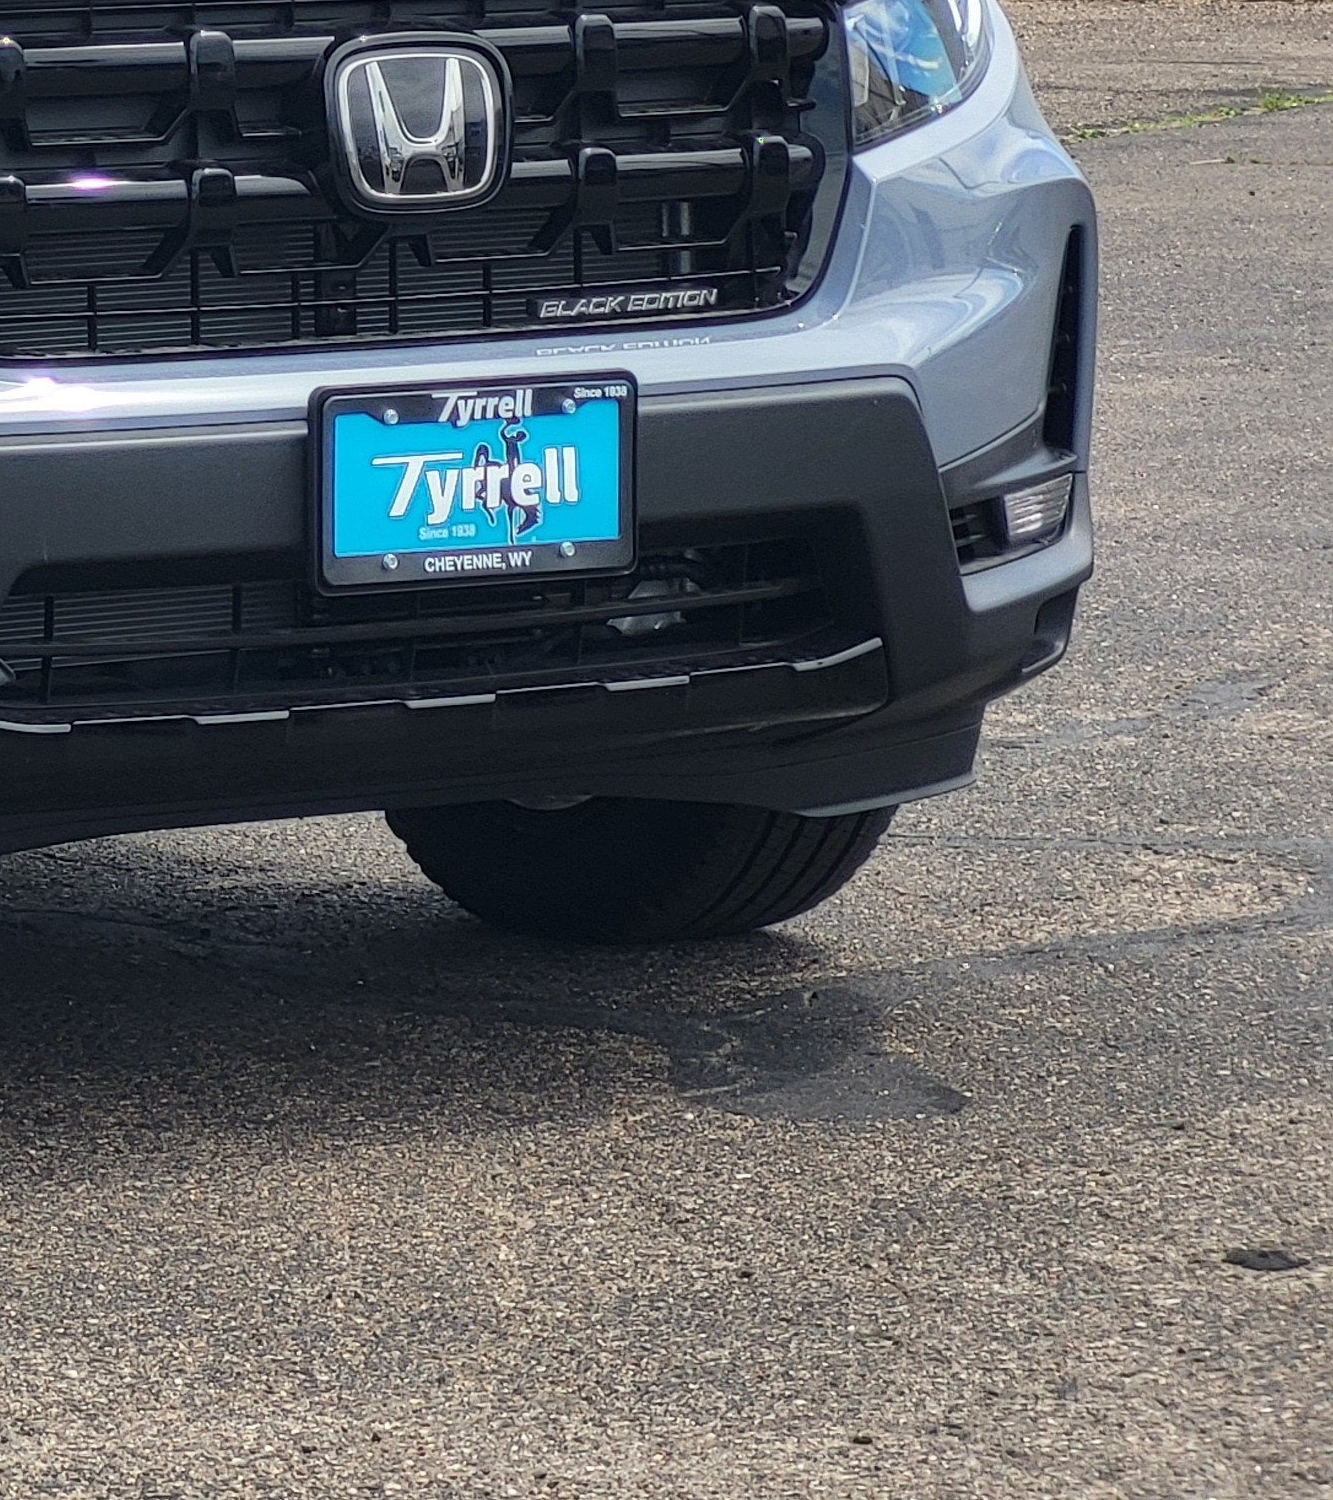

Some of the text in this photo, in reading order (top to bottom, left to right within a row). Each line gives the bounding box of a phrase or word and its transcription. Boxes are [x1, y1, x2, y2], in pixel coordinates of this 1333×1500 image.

[539, 288, 718, 318] BLACK EDITION
[573, 387, 602, 400] Since
[431, 389, 533, 427] Tyrrell
[372, 446, 579, 525] Tyrrell
[419, 526, 449, 541] Since
[424, 551, 533, 573] CHEYENNE, WY
